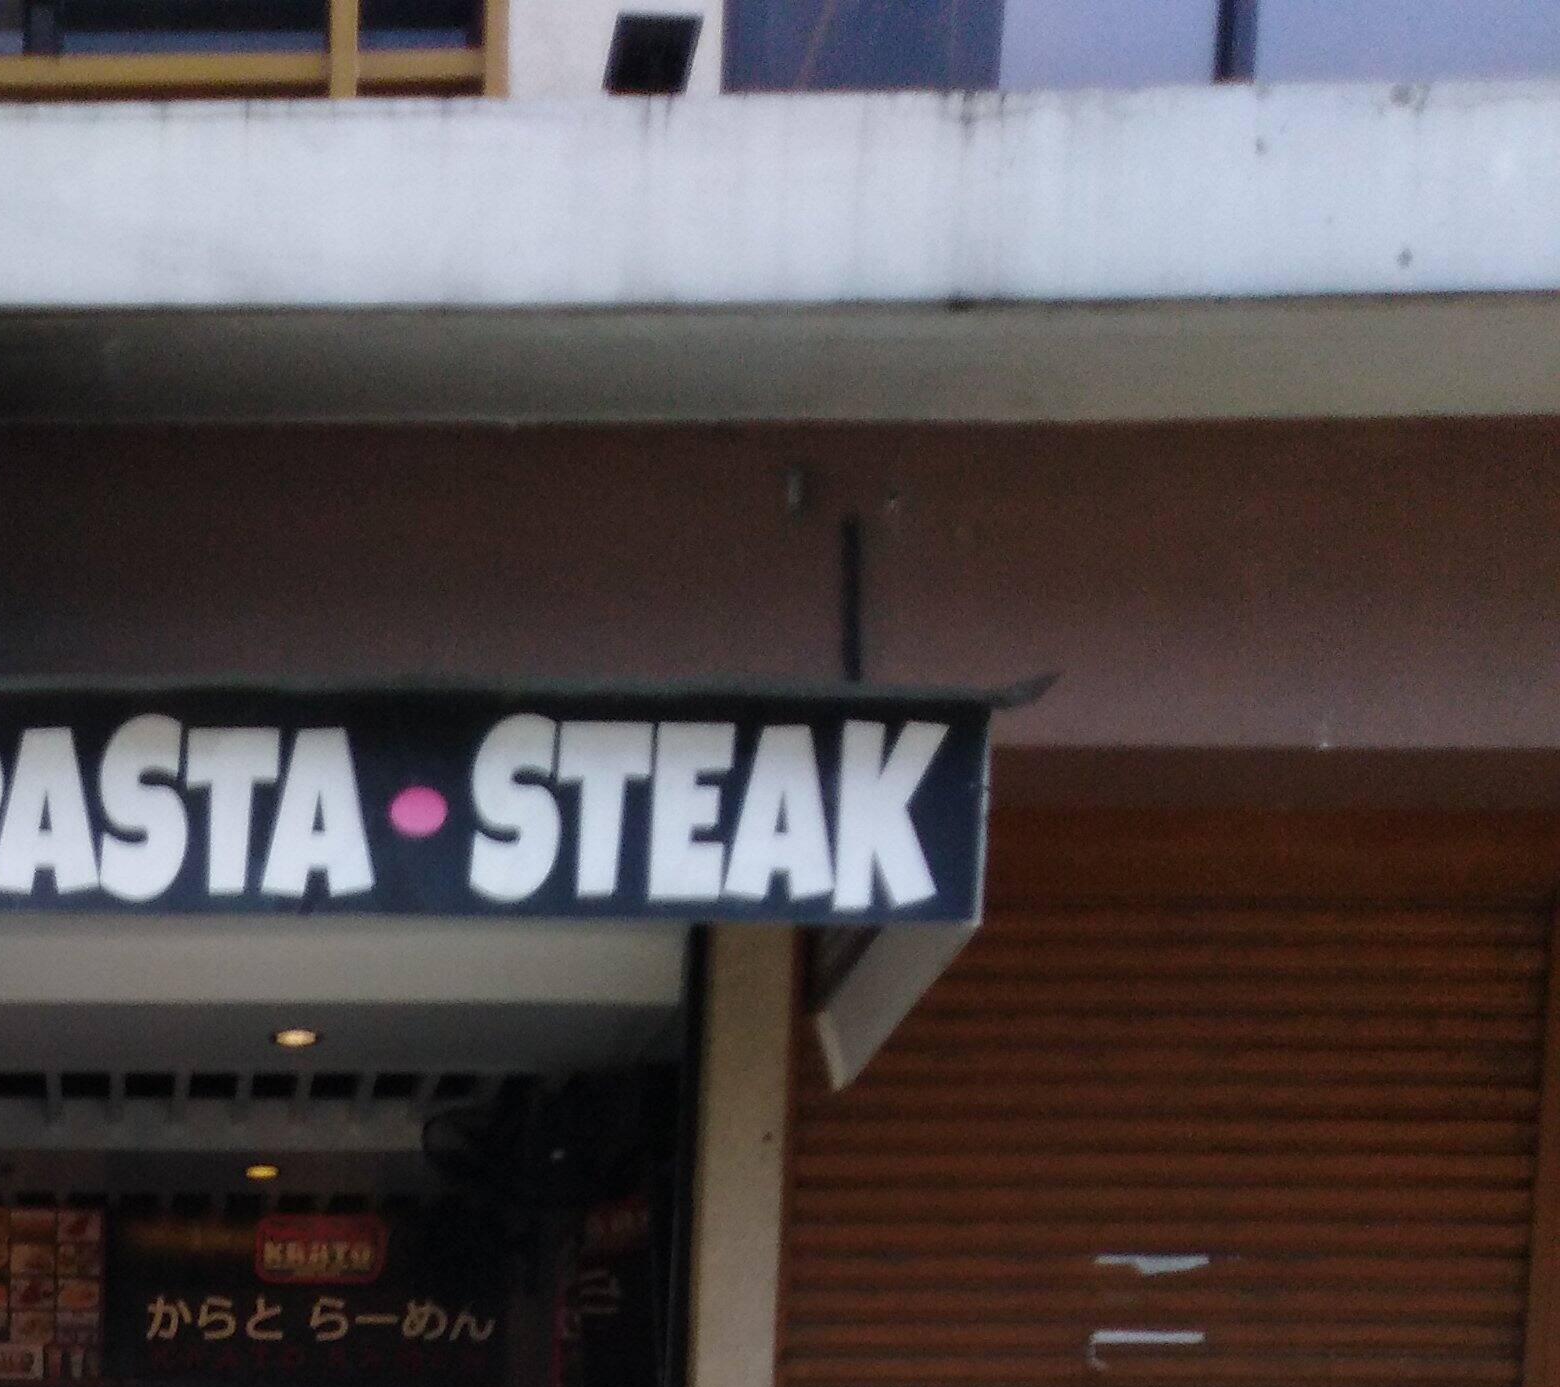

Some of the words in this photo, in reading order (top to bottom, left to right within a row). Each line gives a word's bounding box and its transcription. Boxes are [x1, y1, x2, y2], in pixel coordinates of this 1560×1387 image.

[468, 712, 950, 913] STEAK
[145, 1294, 284, 1342] からと
[308, 1294, 497, 1343] らーめん
